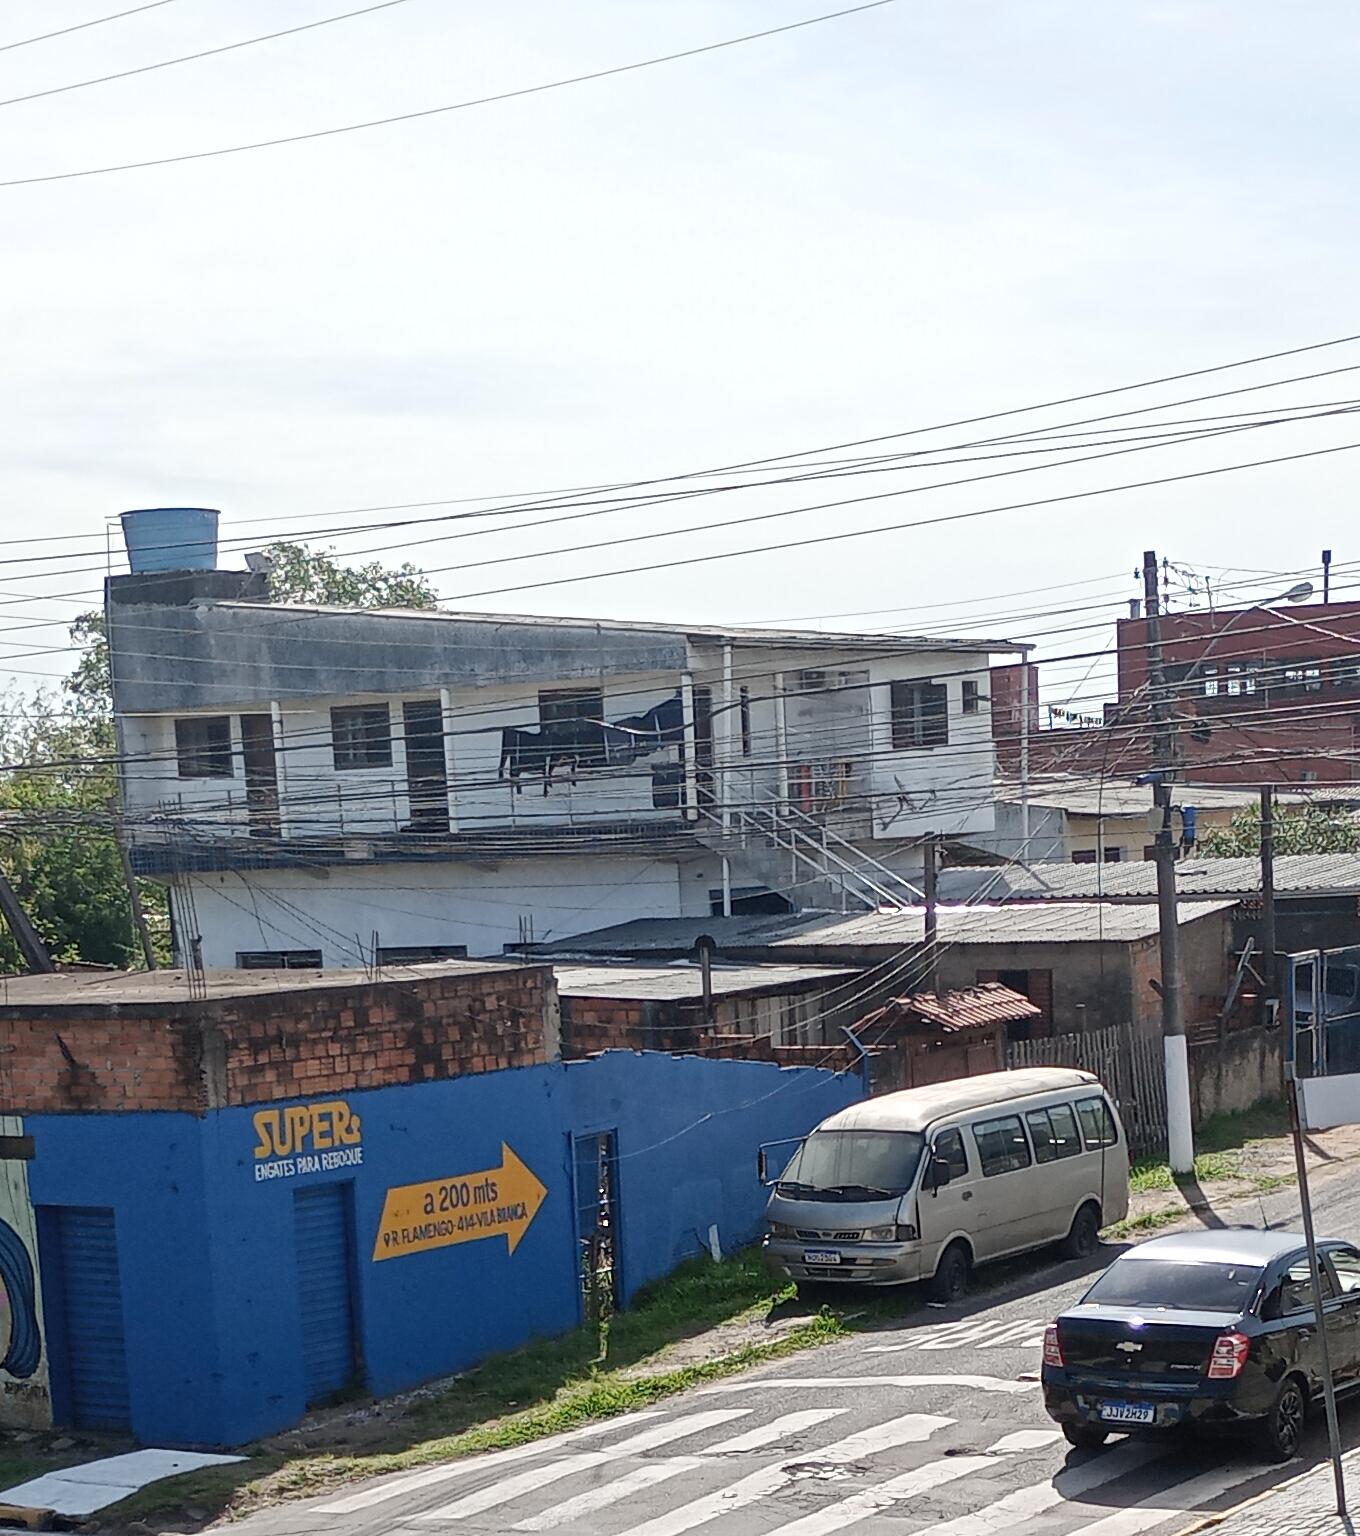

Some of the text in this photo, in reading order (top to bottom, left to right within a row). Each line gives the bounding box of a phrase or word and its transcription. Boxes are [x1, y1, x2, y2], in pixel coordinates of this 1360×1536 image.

[253, 1101, 361, 1158] SUPER
[255, 1147, 363, 1181] ENGATES PARA REBOQUE
[424, 1178, 498, 1215] a 200 mts
[497, 1202, 528, 1225] BRANCA
